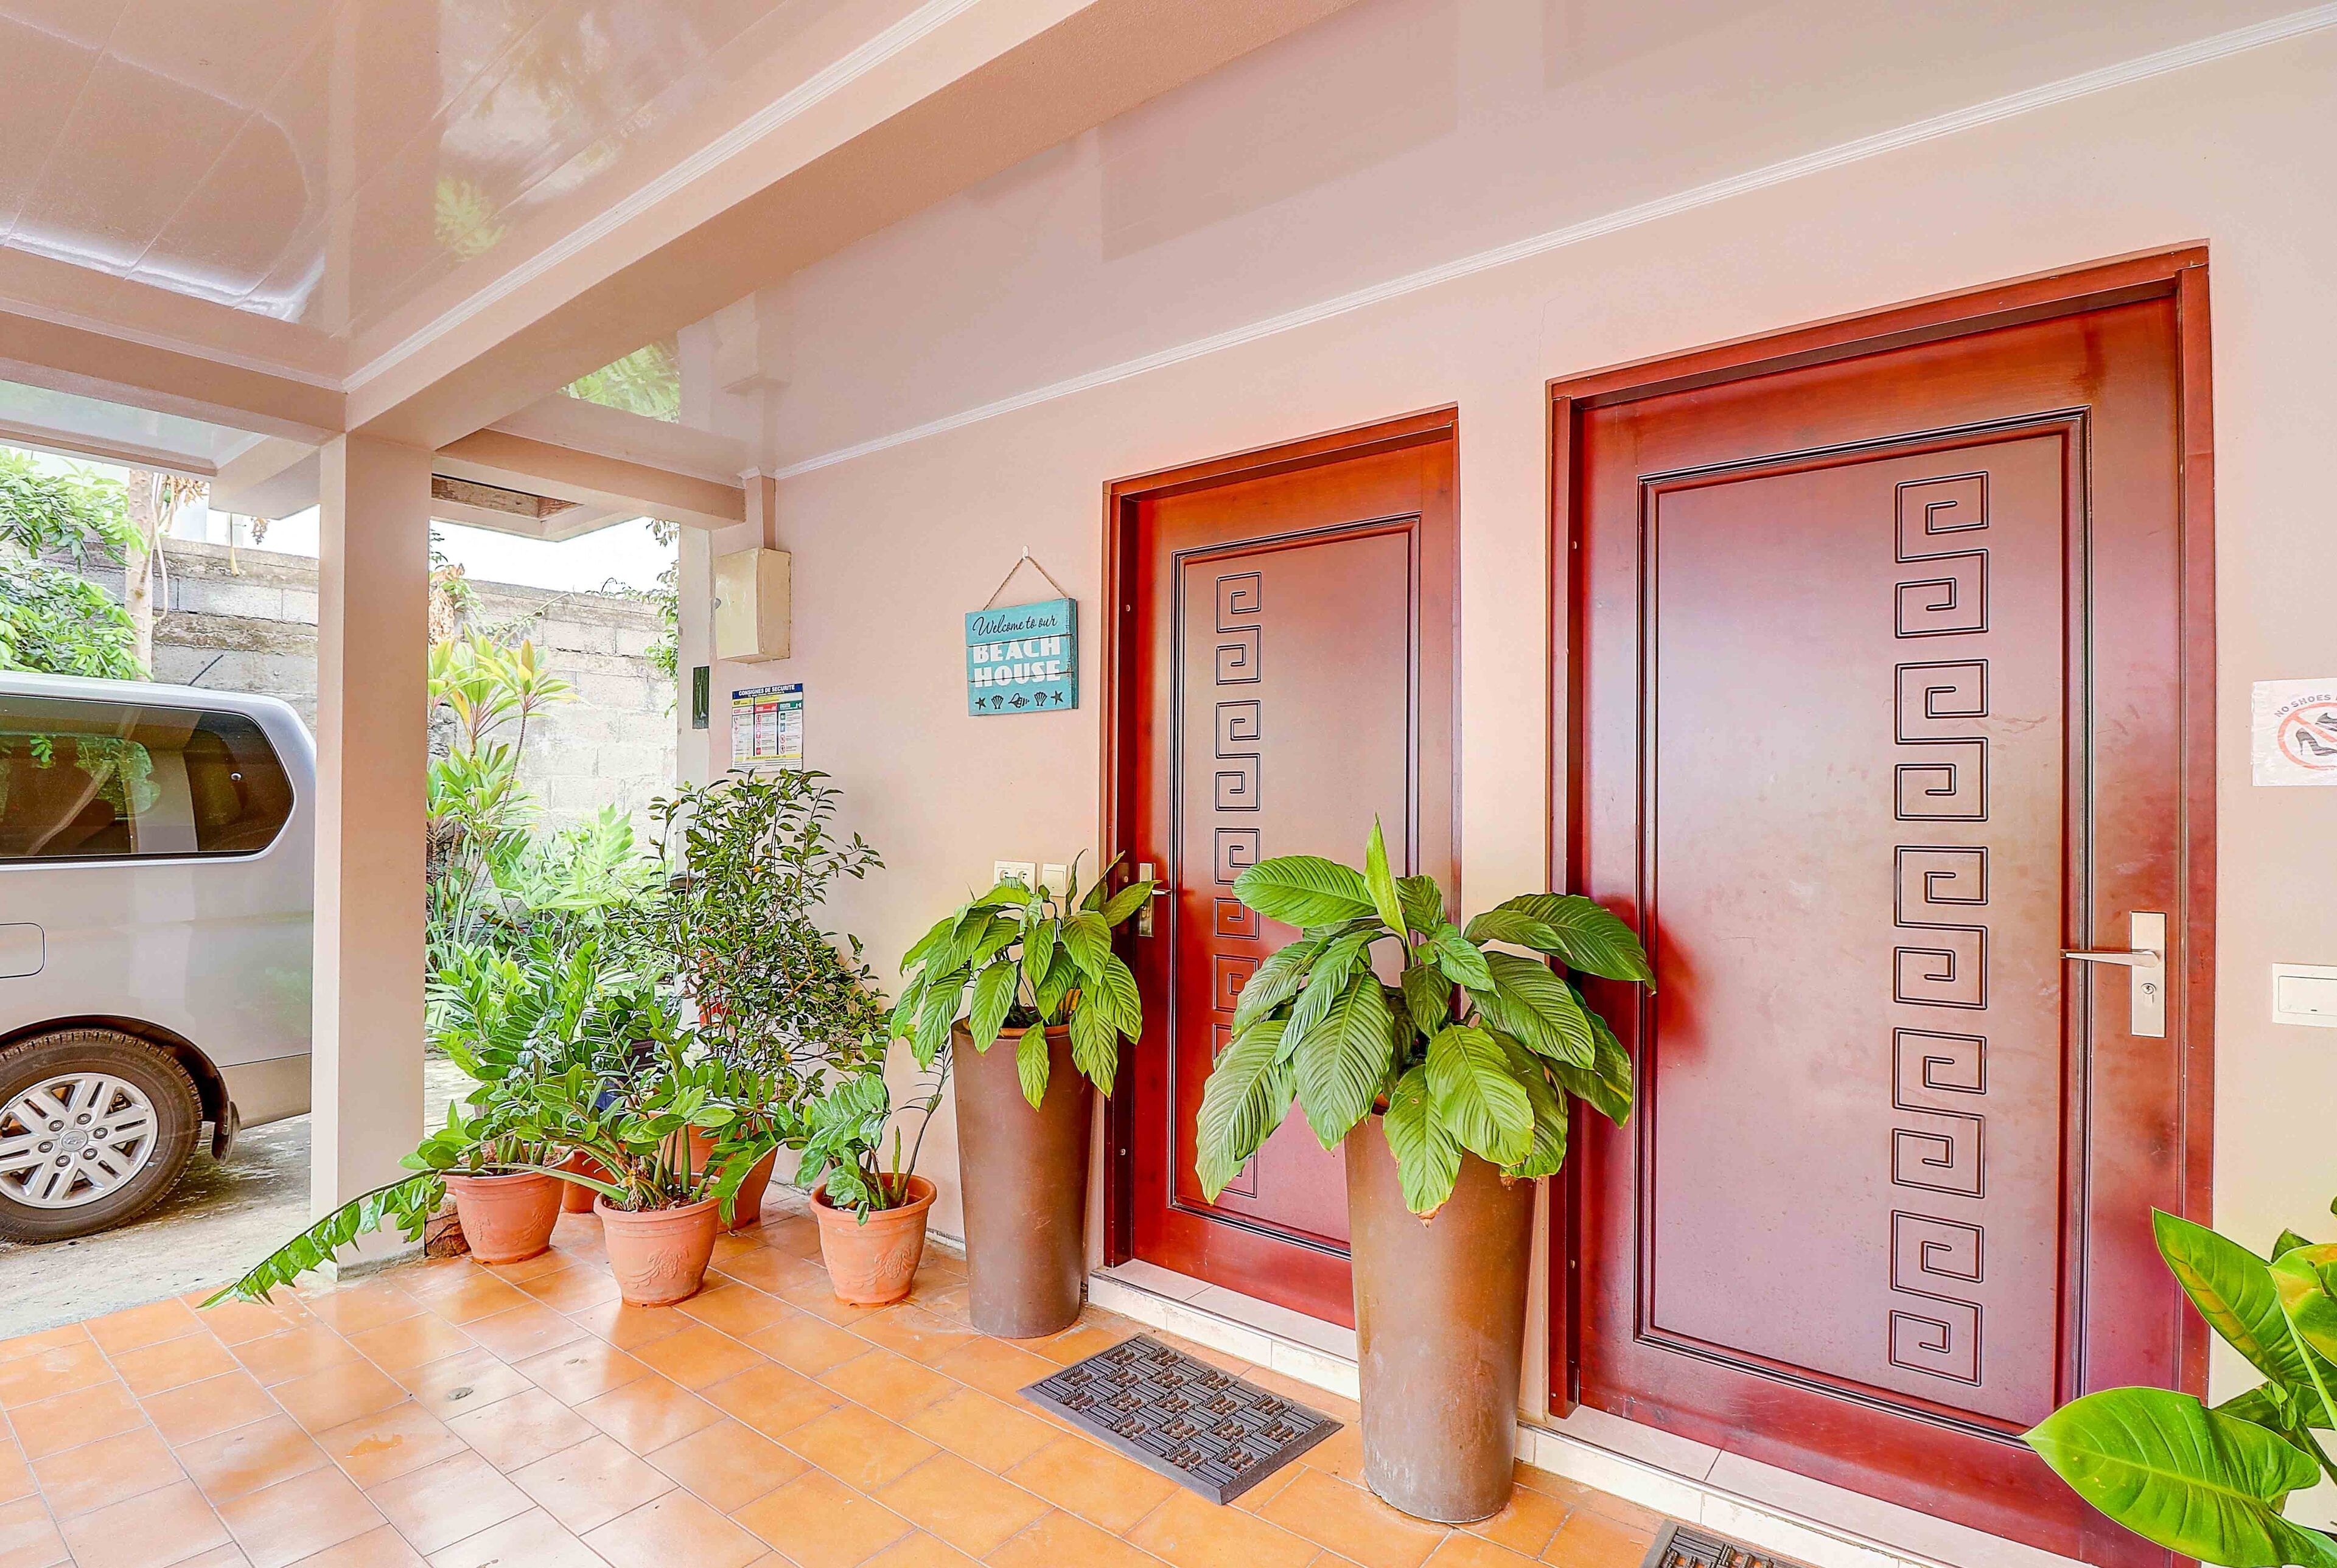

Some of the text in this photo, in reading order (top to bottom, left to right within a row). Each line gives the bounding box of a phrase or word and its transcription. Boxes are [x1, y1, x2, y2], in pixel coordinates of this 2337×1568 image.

[972, 615, 1057, 636] Welcome to our
[973, 635, 1061, 664] BEACH
[974, 660, 1061, 688] HOUSE
[2274, 706, 2290, 717] NO
[2291, 694, 2332, 707] SHOES
